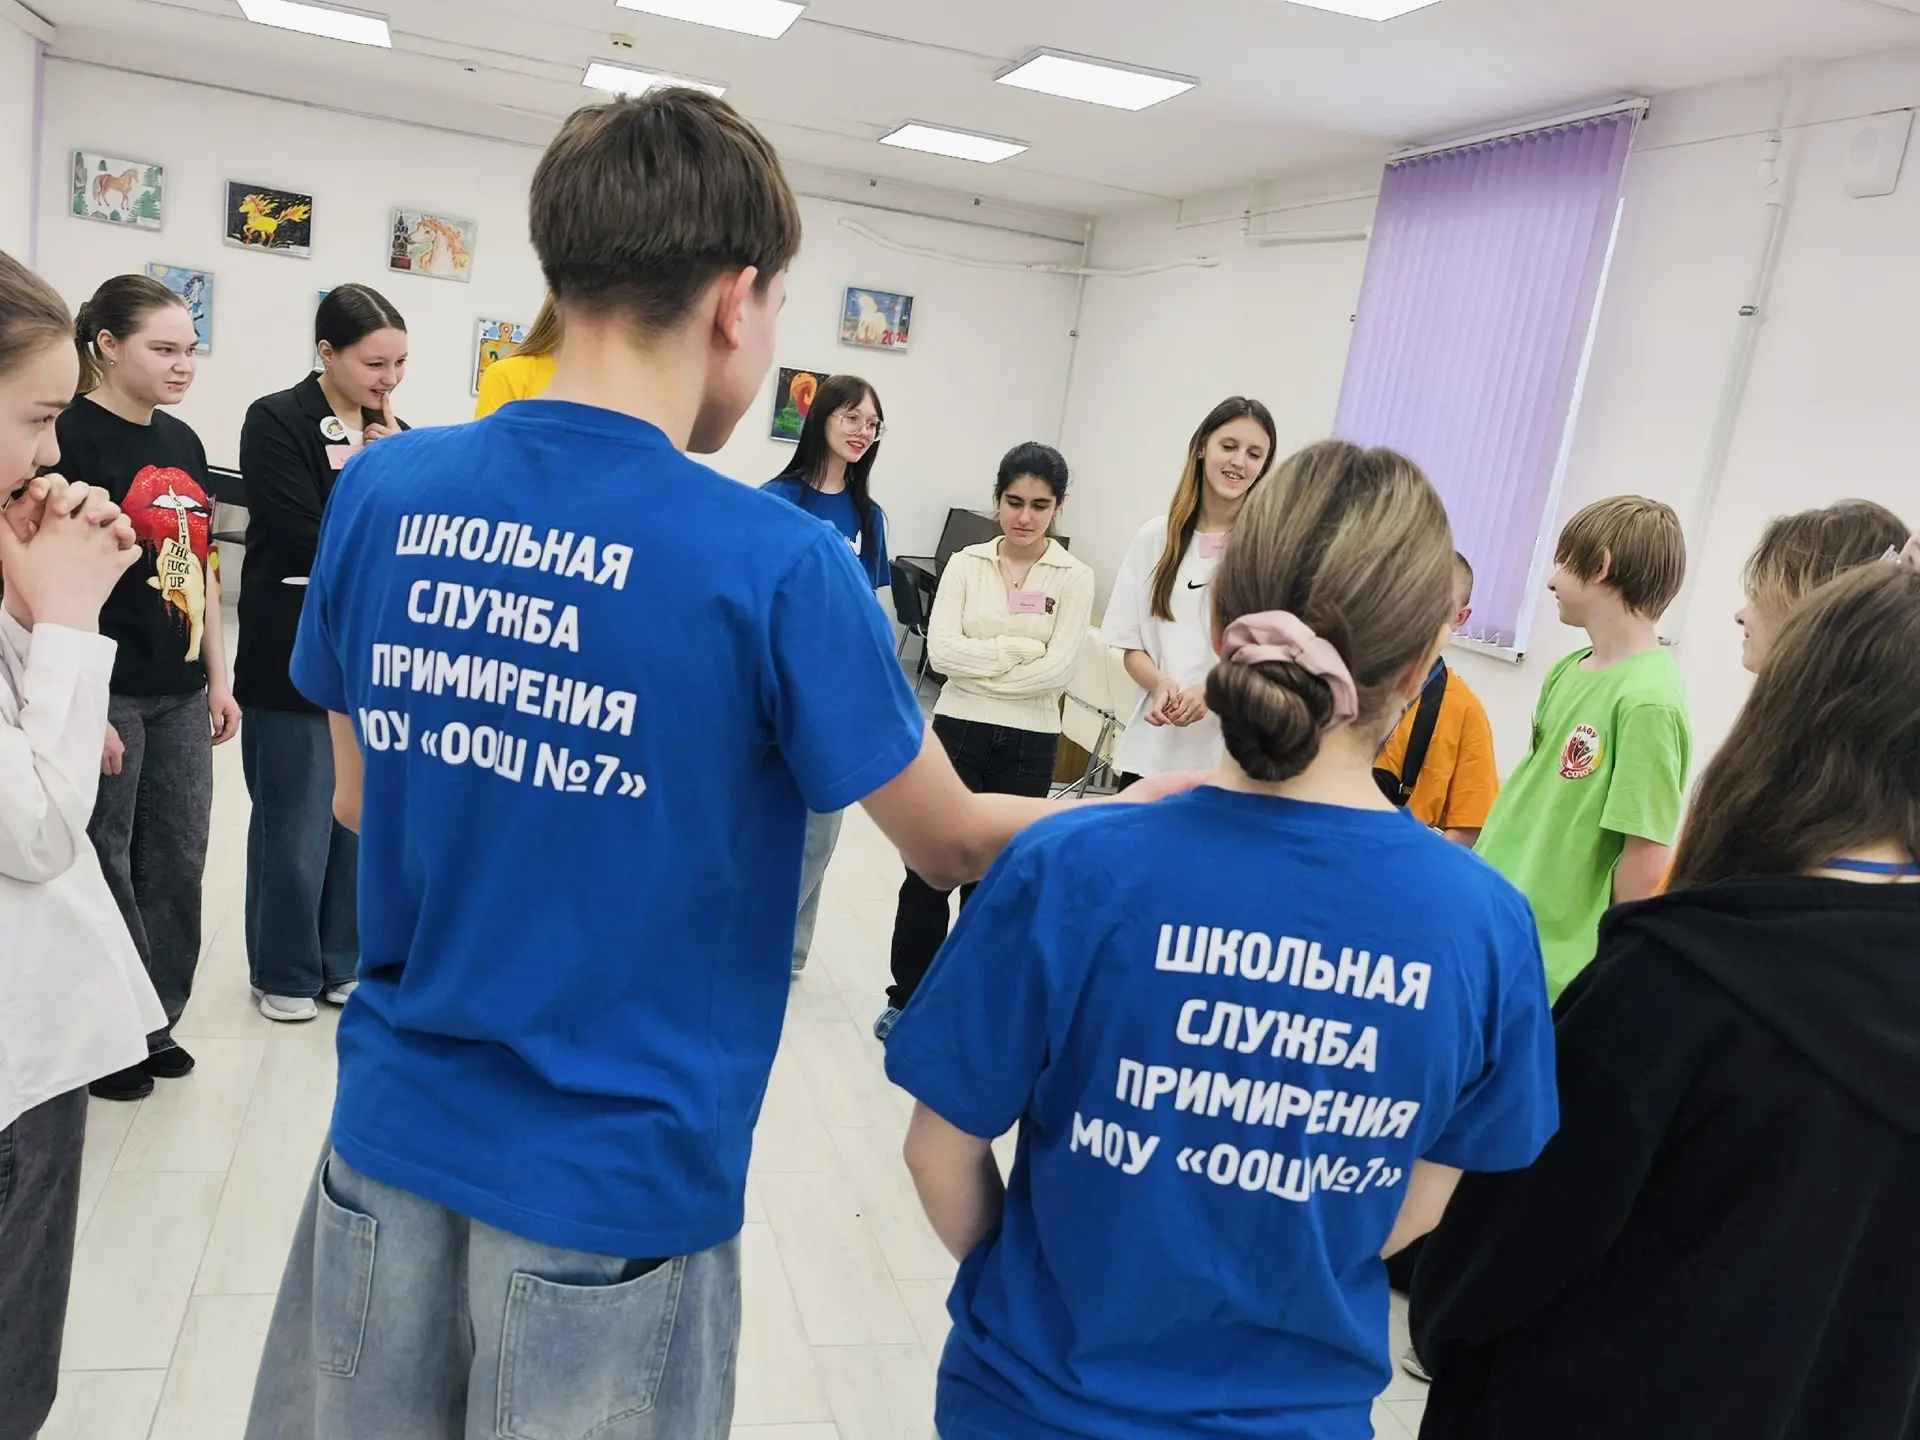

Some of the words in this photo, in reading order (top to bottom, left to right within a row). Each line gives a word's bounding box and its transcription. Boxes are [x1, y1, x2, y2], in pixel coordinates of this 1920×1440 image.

[167, 559, 190, 574] FUCK
[170, 576, 185, 588] UP
[396, 514, 634, 590] ШКОЛЬНАЯ
[407, 579, 579, 653] СЛУЖБА
[372, 643, 637, 736] ПРИМИРЕНИЯ
[1155, 924, 1432, 1010] ШКОЛЬНАЯ
[1176, 999, 1378, 1073] СЛУЖБА
[1115, 1057, 1420, 1139] ПРИМИРЕНИЯ
[1070, 1111, 1160, 1175] МОУ
